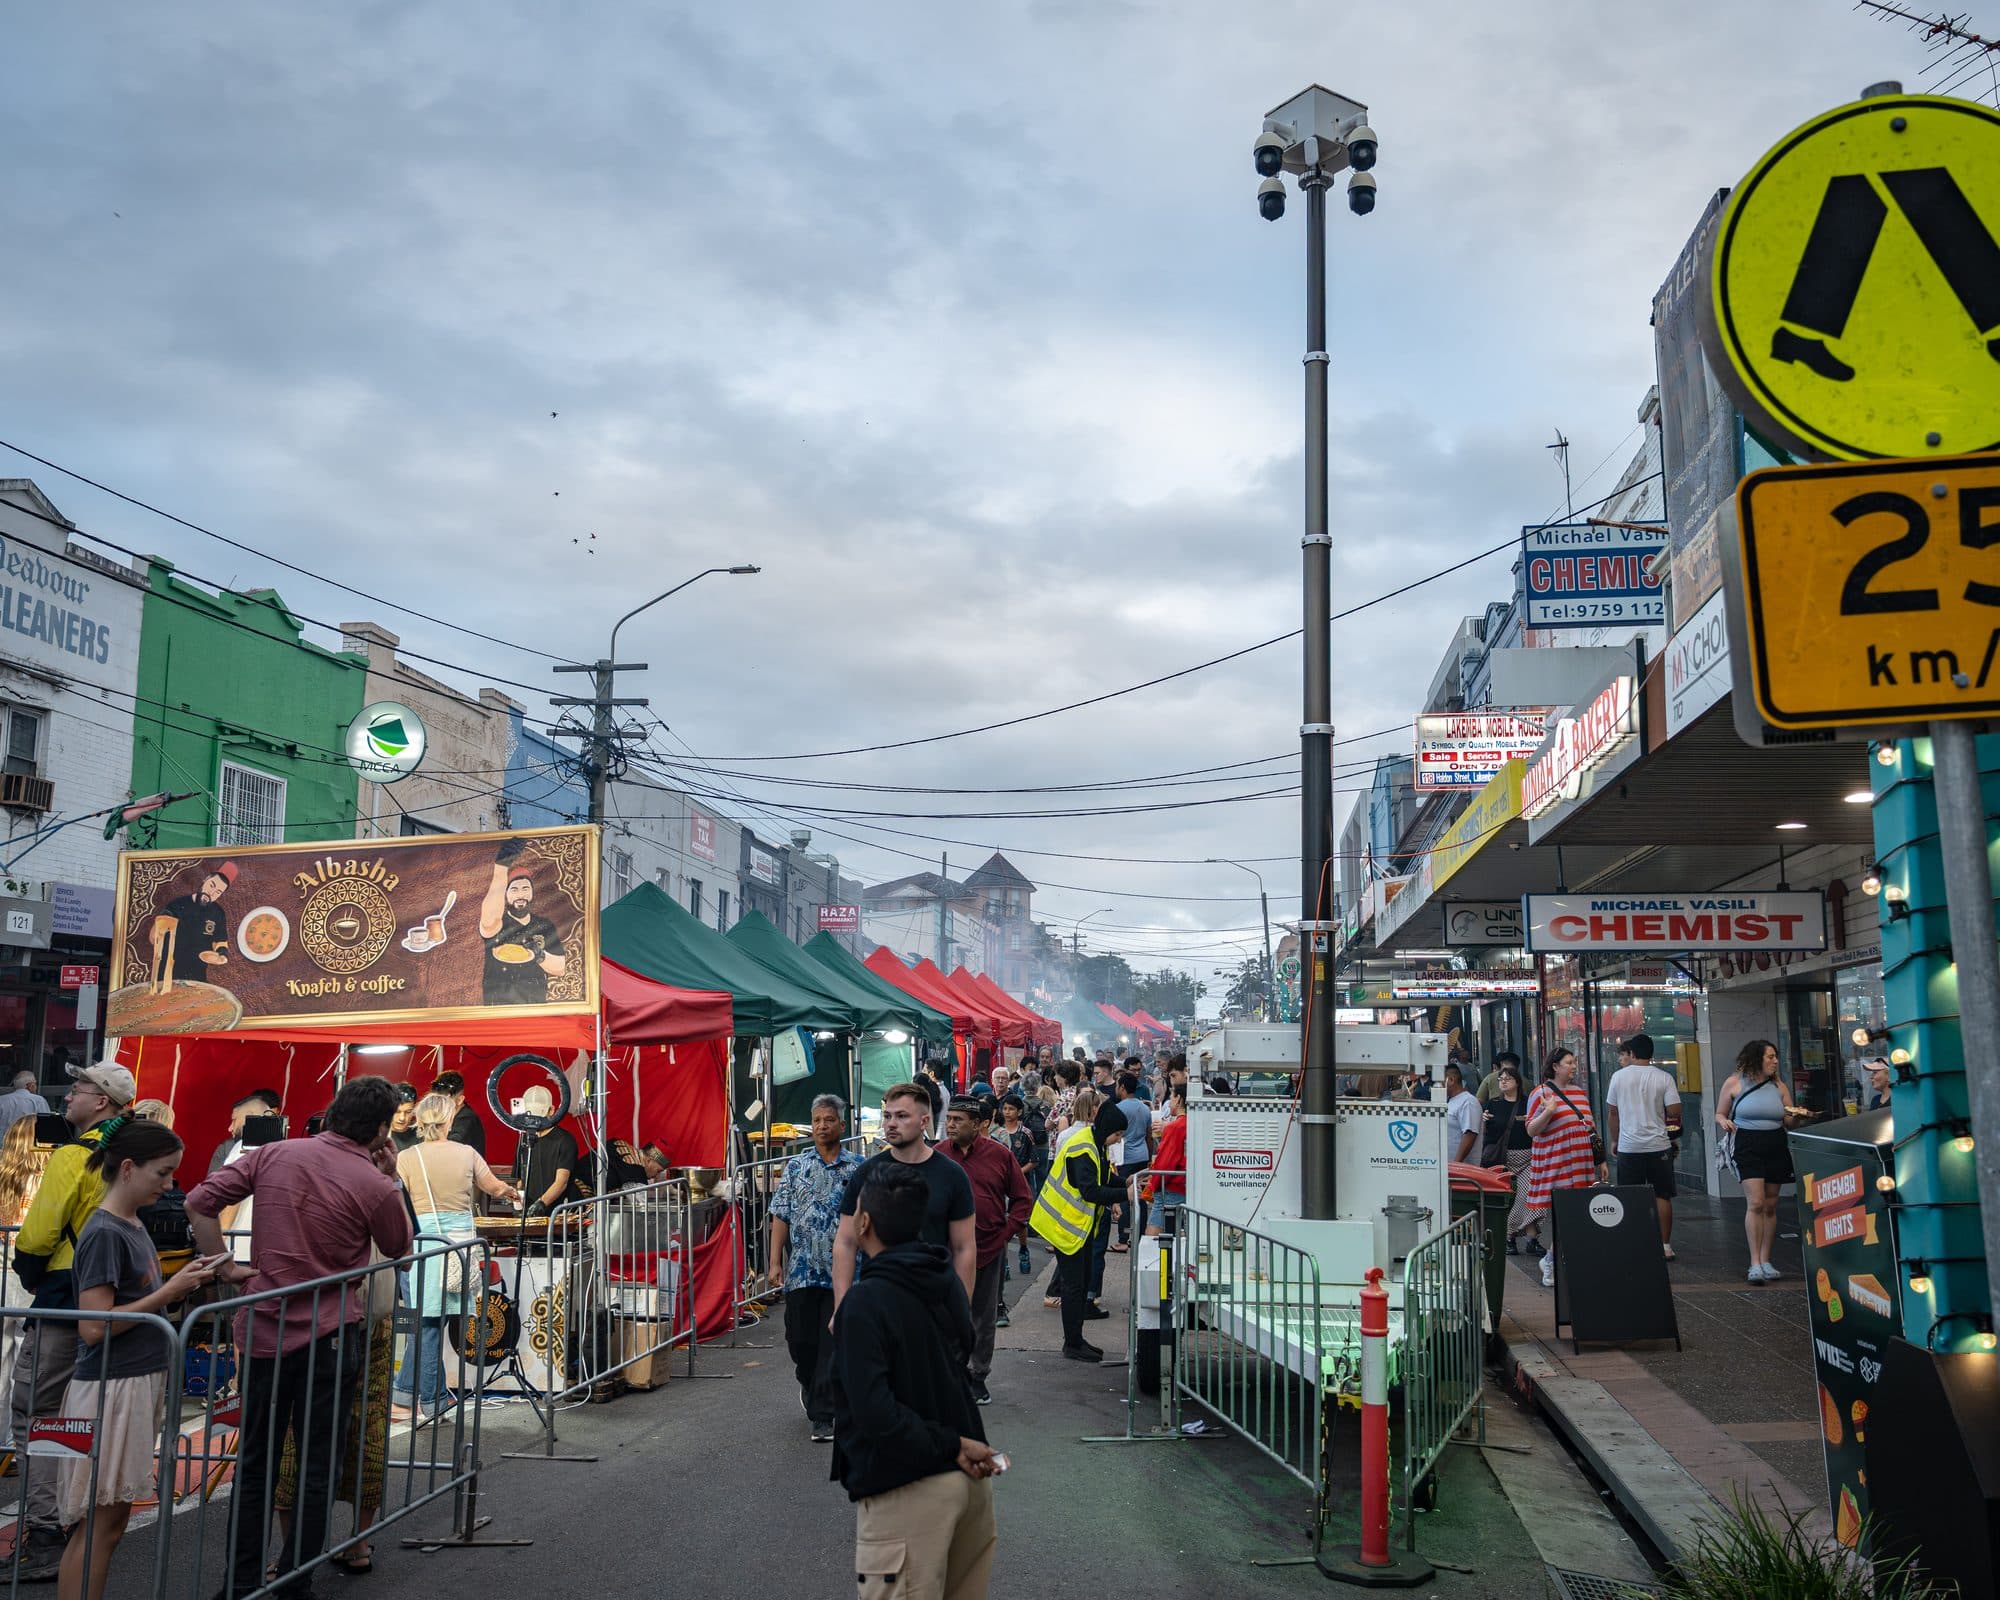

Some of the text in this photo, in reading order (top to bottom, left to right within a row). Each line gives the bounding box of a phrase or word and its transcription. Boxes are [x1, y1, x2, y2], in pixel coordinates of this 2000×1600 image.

[1537, 528, 1611, 545] Michael
[1630, 602, 1664, 616] 112
[0, 583, 110, 665] LEANERS
[1446, 717, 1544, 739] LAKEMBA MOBILE HOUSE
[1572, 677, 1620, 772] BAKERY
[1421, 742, 1427, 750] A
[1429, 753, 1451, 761] Sale
[1466, 752, 1499, 761] Service
[697, 828, 710, 846] TAX
[293, 856, 400, 899] Albasha
[1591, 899, 1756, 911] MICHAEL VASILI
[821, 907, 857, 917] RAZA
[13, 916, 28, 929] 121
[1548, 914, 1803, 942] CHEMIST
[1415, 970, 1536, 981] LAKEMBA MOBILE HOUSE
[1631, 967, 1663, 977] DENTIST
[344, 977, 358, 992] &
[360, 974, 405, 994] coffee
[1216, 1155, 1270, 1166] WARNING
[1370, 1156, 1437, 1165] MOBILE CCTV
[1228, 1171, 1247, 1179] hour
[1249, 1171, 1271, 1180] video
[1219, 1180, 1268, 1188] surveillance
[1817, 1173, 1856, 1204] LAKEMBA
[1823, 1213, 1854, 1241] NIGHTS
[32, 1418, 93, 1434] Camden HIRE
